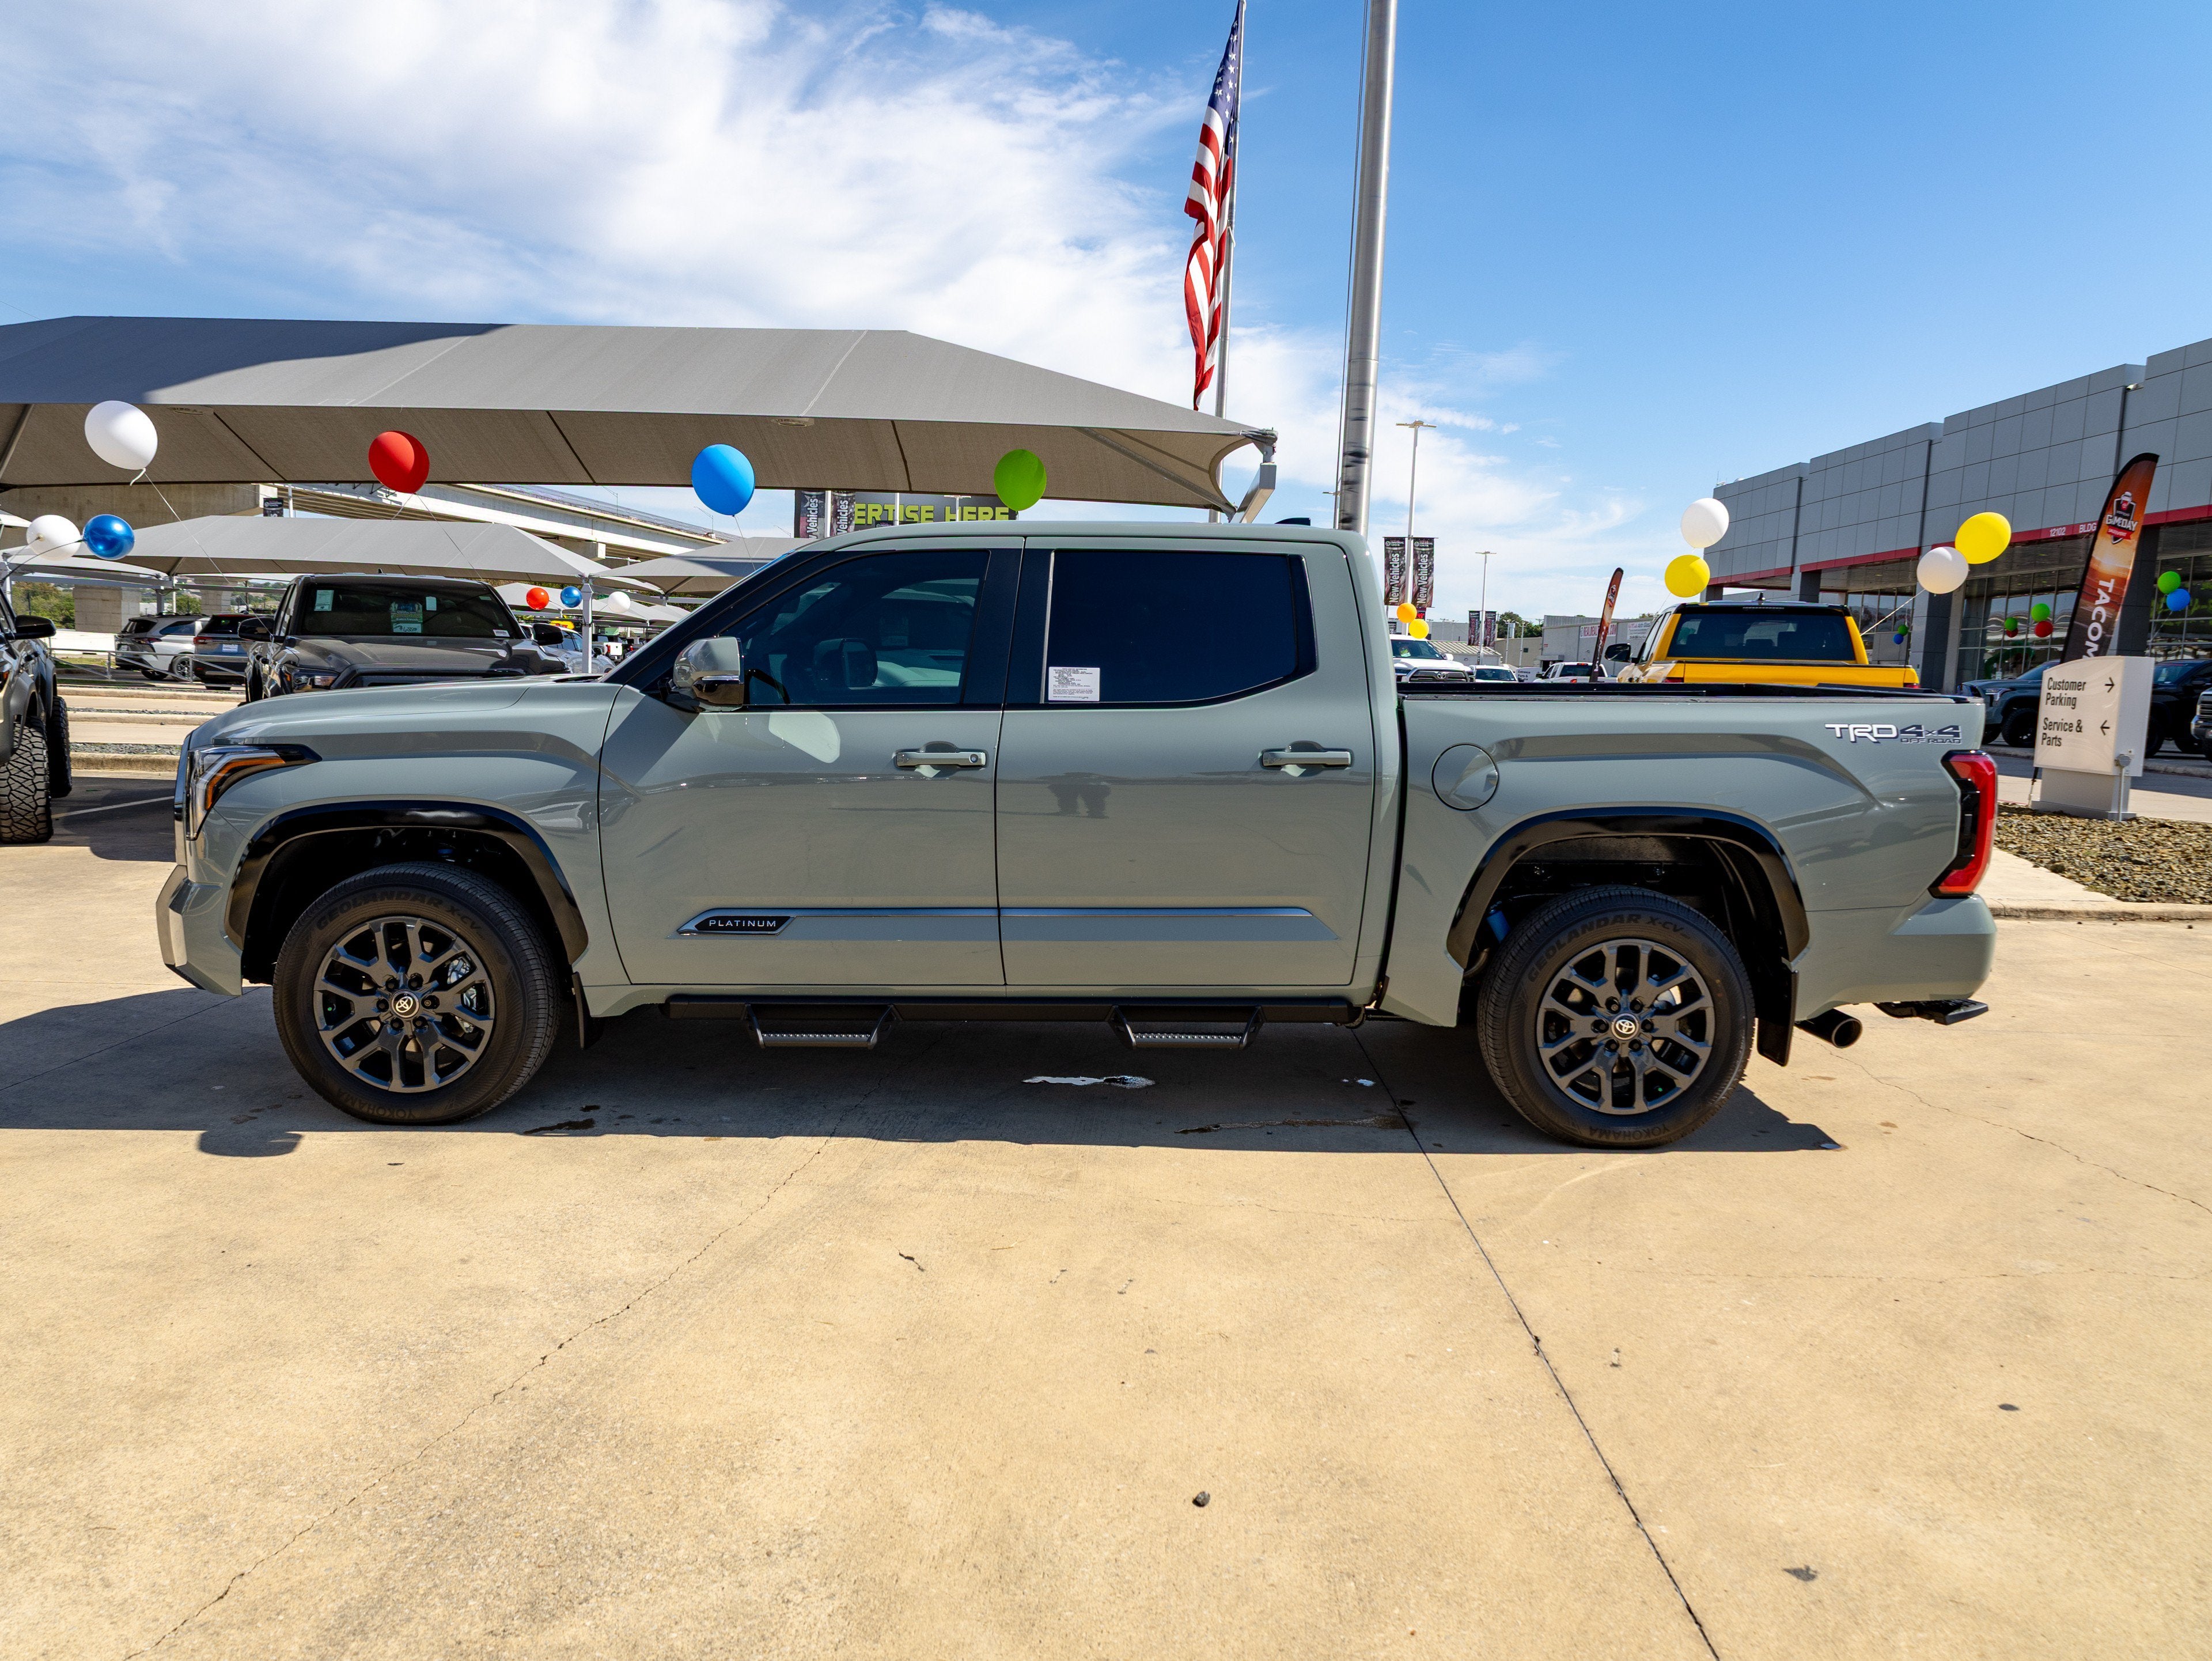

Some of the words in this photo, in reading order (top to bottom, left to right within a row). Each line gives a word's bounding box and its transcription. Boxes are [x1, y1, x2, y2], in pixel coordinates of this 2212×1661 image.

[807, 498, 818, 533] Vehicles
[837, 500, 849, 535] Vehicles
[945, 506, 1009, 521] HERE
[2050, 527, 2066, 537] 12102
[2079, 523, 2097, 534] BLDG
[1389, 553, 1400, 585] Vehicles
[1418, 554, 1428, 585] Vehicles
[1389, 587, 1399, 603] New
[1417, 587, 1427, 604] New
[2047, 677, 2086, 691] Customer
[2046, 693, 2077, 709] Parking
[2043, 717, 2073, 732] Service
[2075, 720, 2082, 733] &
[1825, 724, 1900, 743] TRD
[1900, 725, 1963, 739] 4x4
[2041, 732, 2062, 747] Parts
[1528, 914, 1642, 982] GEOLANDAR
